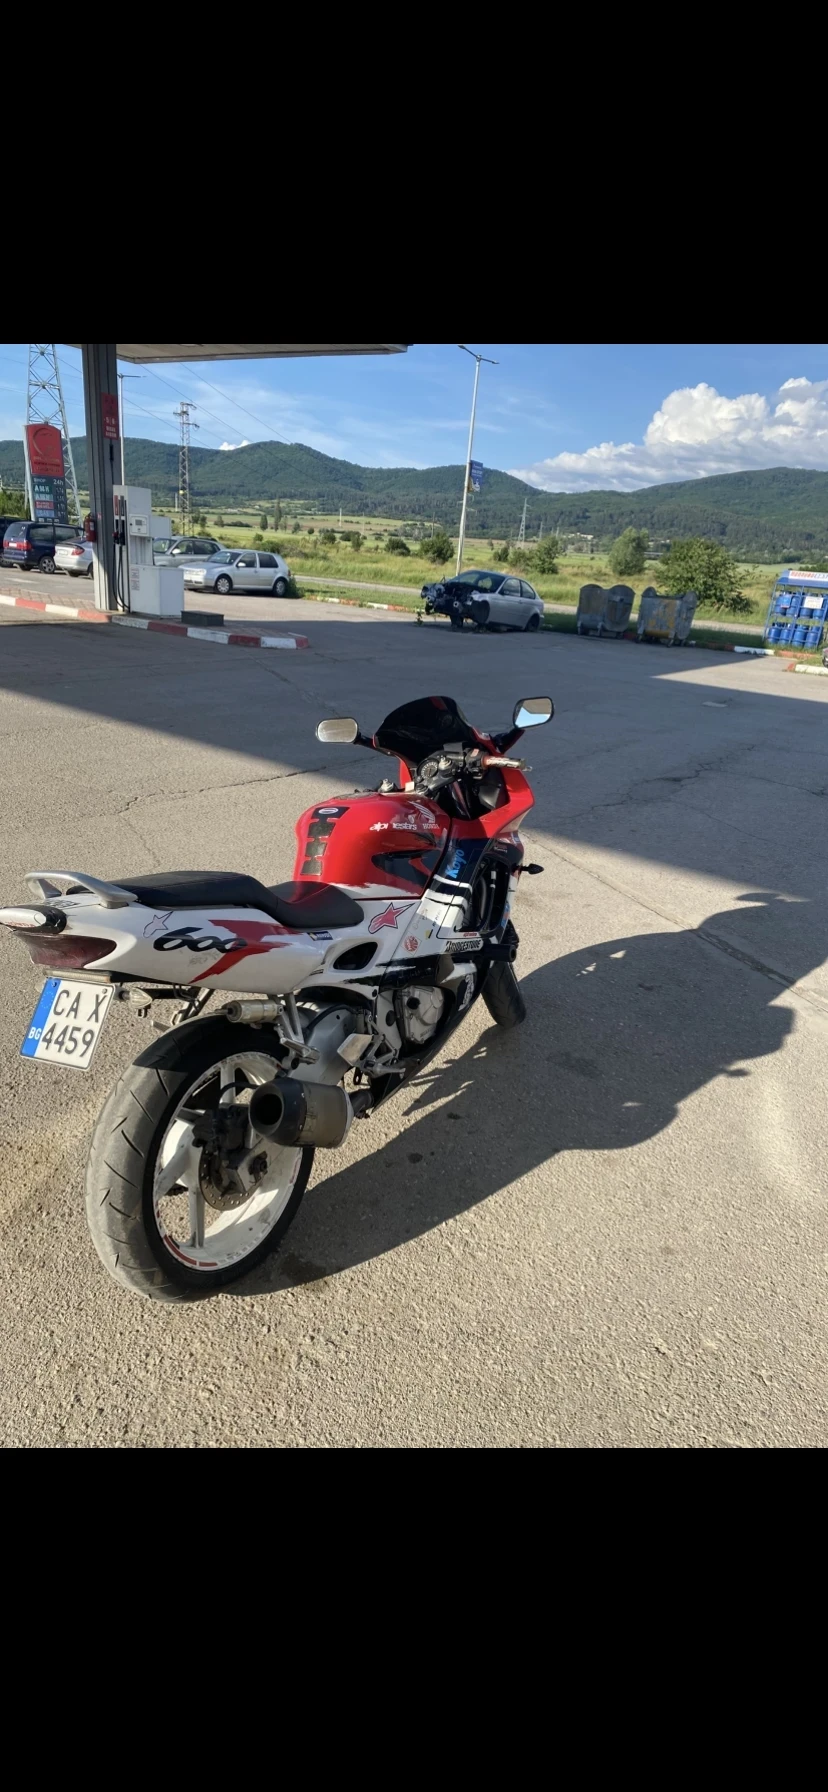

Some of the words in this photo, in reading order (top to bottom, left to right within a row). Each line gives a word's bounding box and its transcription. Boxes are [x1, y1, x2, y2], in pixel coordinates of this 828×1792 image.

[445, 849, 467, 879] Koyo
[153, 926, 248, 954] 600
[53, 989, 82, 1019] CA
[87, 993, 108, 1023] X
[28, 1026, 42, 1040] BG
[42, 1022, 95, 1058] 4459
